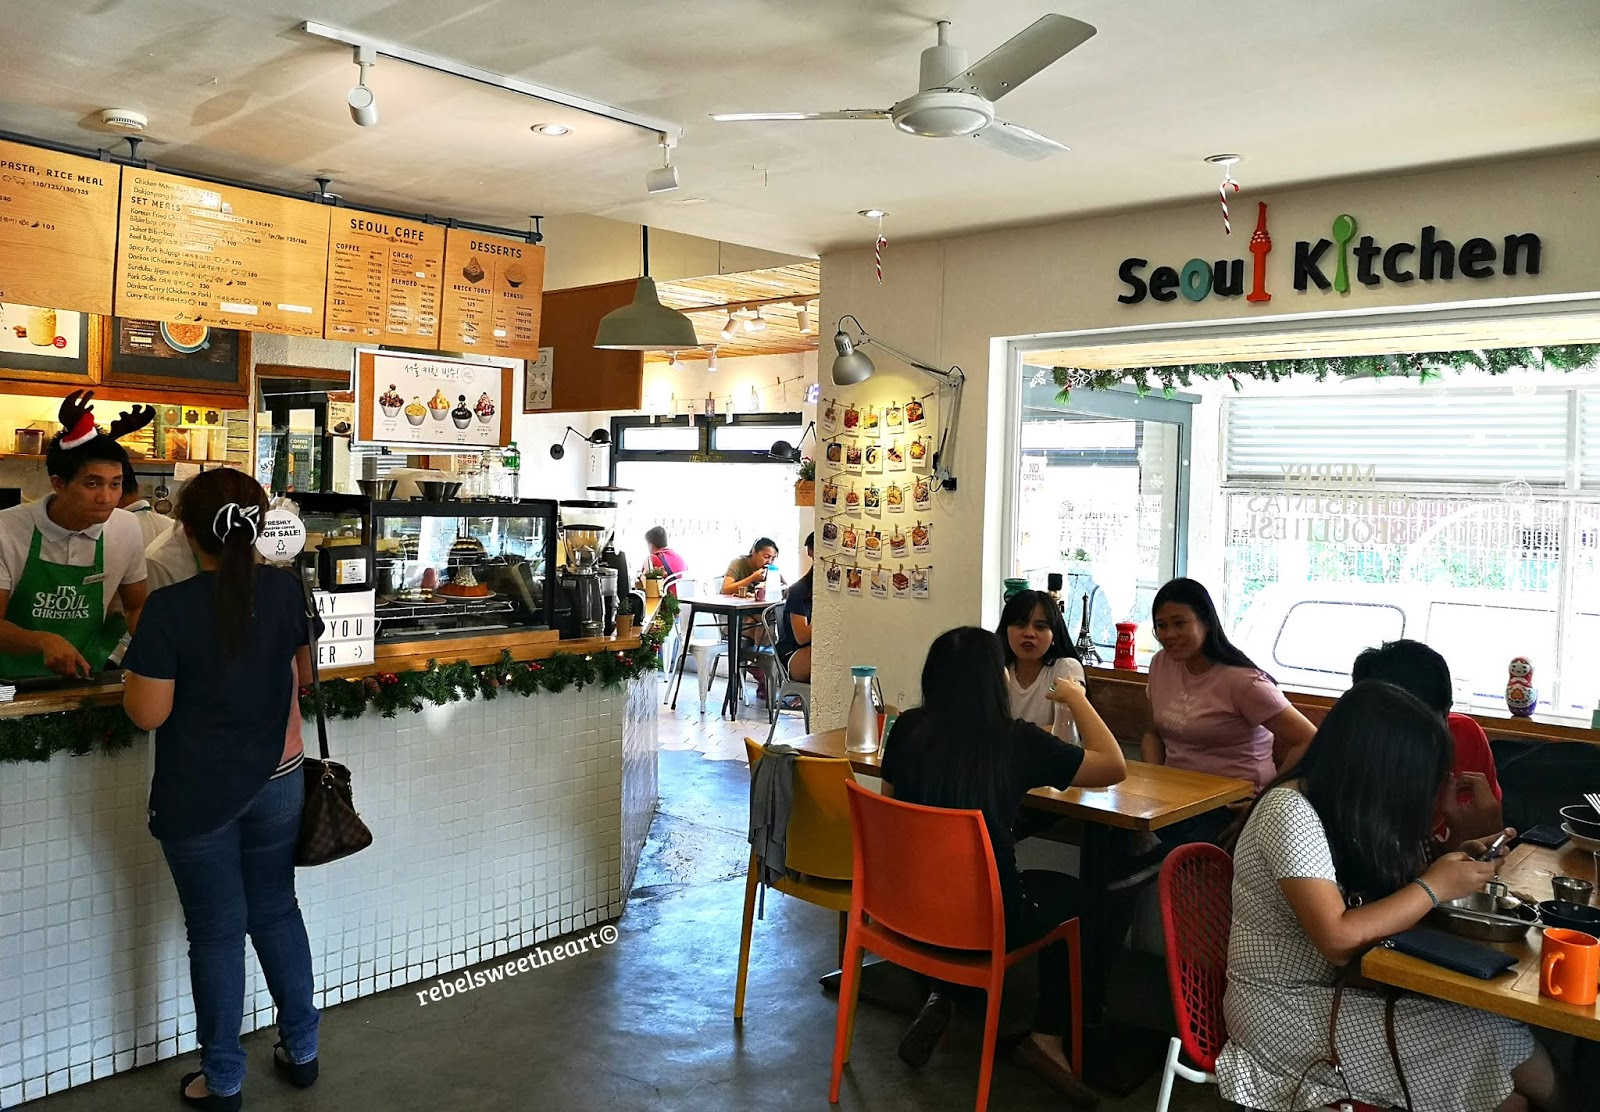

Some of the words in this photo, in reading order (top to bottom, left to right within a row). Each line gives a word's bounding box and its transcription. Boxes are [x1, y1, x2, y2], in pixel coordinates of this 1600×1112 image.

[0, 160, 41, 176] PASTA,
[46, 168, 73, 181] RICE
[77, 174, 104, 187] MEAL
[134, 177, 157, 187] Chicken
[130, 195, 148, 205] SET
[151, 199, 181, 212] MEALS
[350, 218, 389, 235] SEOUL
[394, 226, 424, 242] CAFE
[335, 242, 360, 252] COFFEE
[470, 240, 522, 259] DESSERTS
[392, 251, 414, 260] CACAO
[1117, 201, 1272, 305] Seoul
[1293, 213, 1543, 293] Kitchen
[391, 278, 418, 287] BLENDED
[453, 284, 472, 292] BRICK
[474, 287, 491, 295] TOAST
[126, 291, 143, 300] Curry
[503, 291, 524, 300] BINGSU
[333, 298, 346, 306] TEA
[277, 529, 301, 537] SALE!
[56, 585, 77, 597] IT'S
[33, 591, 90, 611] SEOUL
[32, 607, 89, 620] CHRISTMAS
[330, 618, 363, 638] YOU
